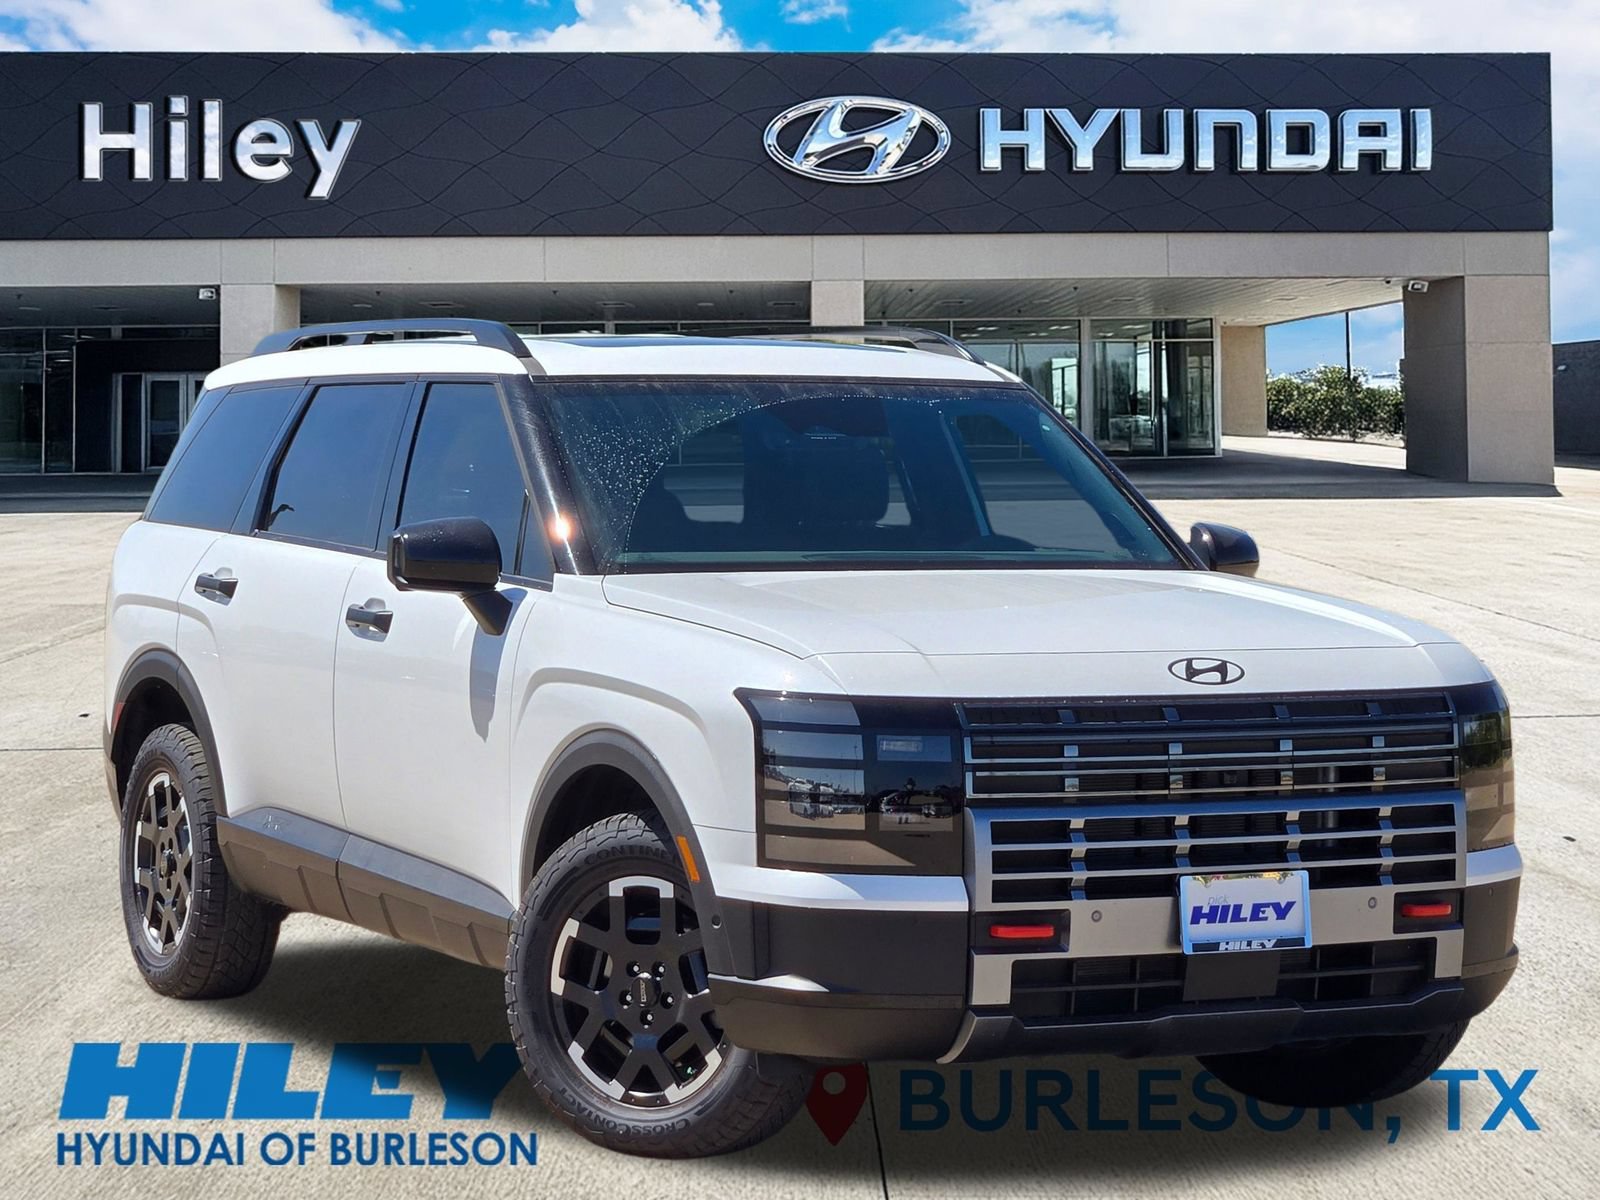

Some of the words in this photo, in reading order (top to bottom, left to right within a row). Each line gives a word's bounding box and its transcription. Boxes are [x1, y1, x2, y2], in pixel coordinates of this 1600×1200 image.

[80, 95, 361, 199] Hiley
[979, 108, 1431, 172] HYUNDAI
[1190, 901, 1296, 925] HILEY
[1218, 939, 1278, 951] HILEY
